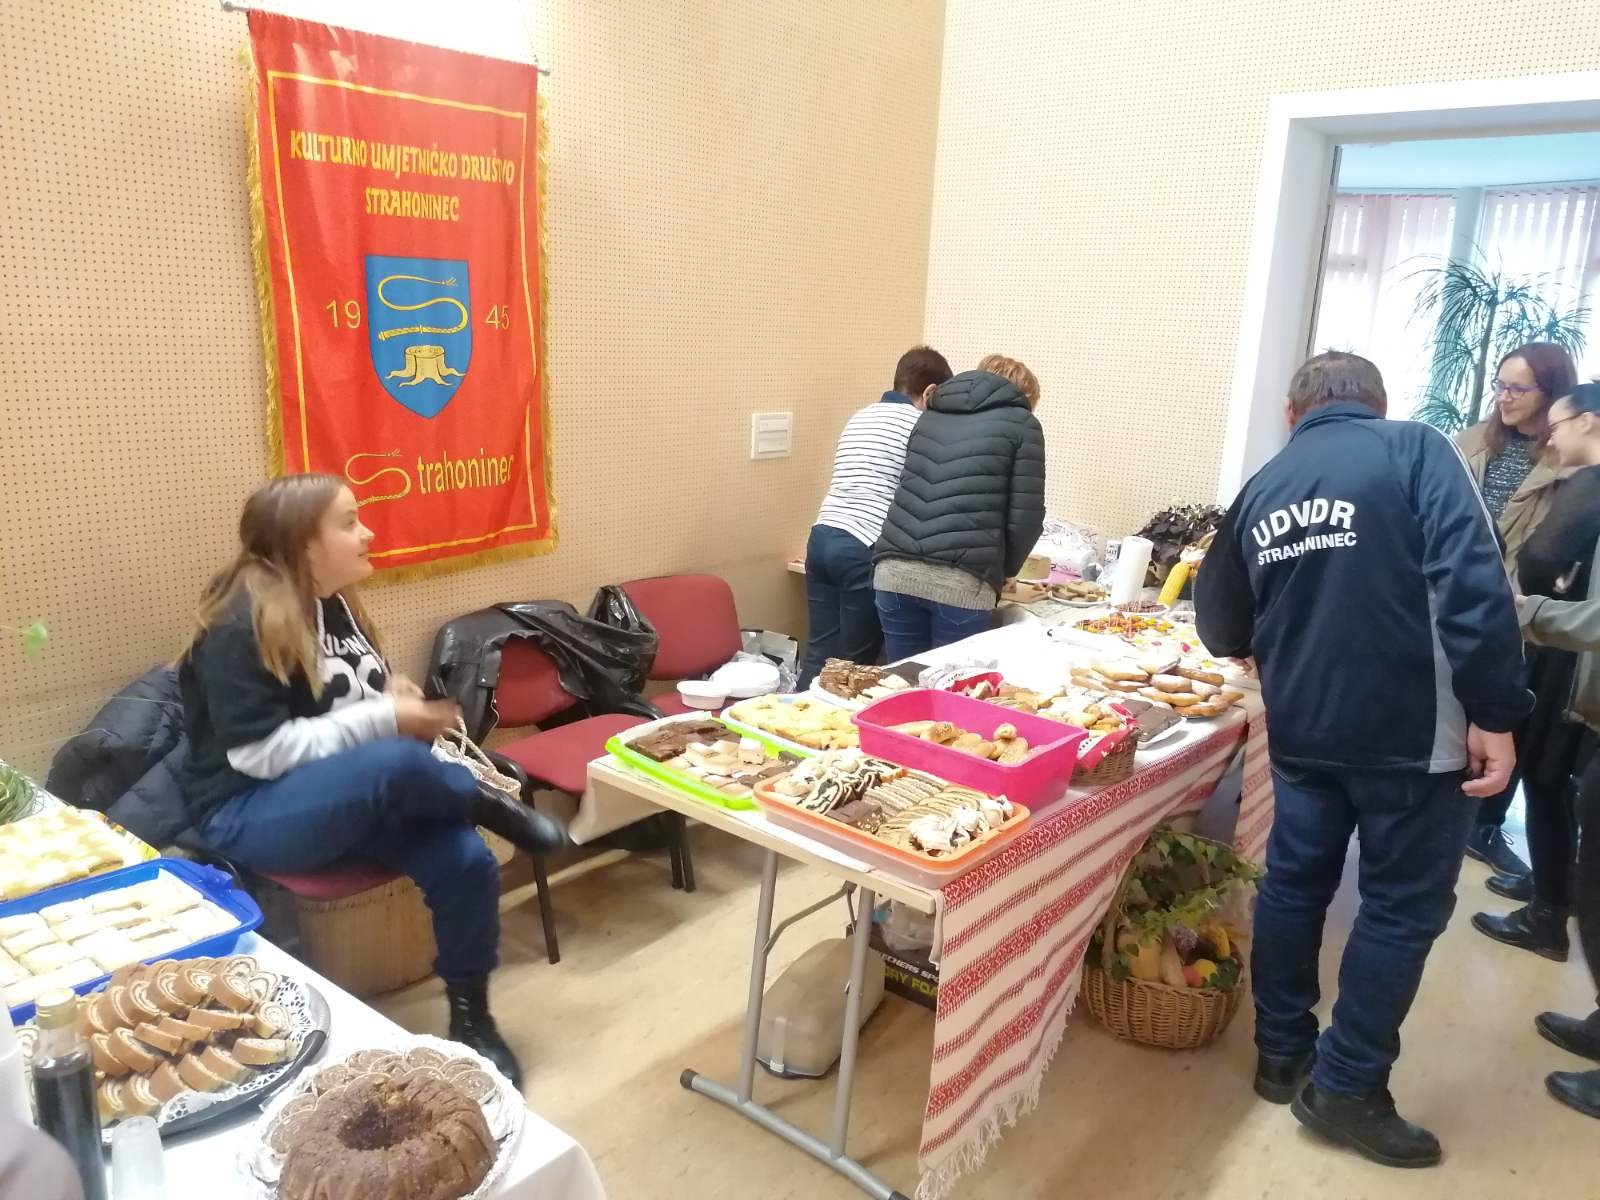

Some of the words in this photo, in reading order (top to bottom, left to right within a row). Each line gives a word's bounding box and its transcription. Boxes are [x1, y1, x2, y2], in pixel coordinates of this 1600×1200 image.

[290, 130, 367, 166] KULTURNO
[371, 142, 458, 179] UMJETNIČKO
[365, 187, 460, 222] STRAHONINEC
[325, 300, 361, 329] 19
[485, 304, 510, 330] 45
[1252, 498, 1356, 548] UDVDR
[1258, 532, 1357, 565] STRAHNINEC
